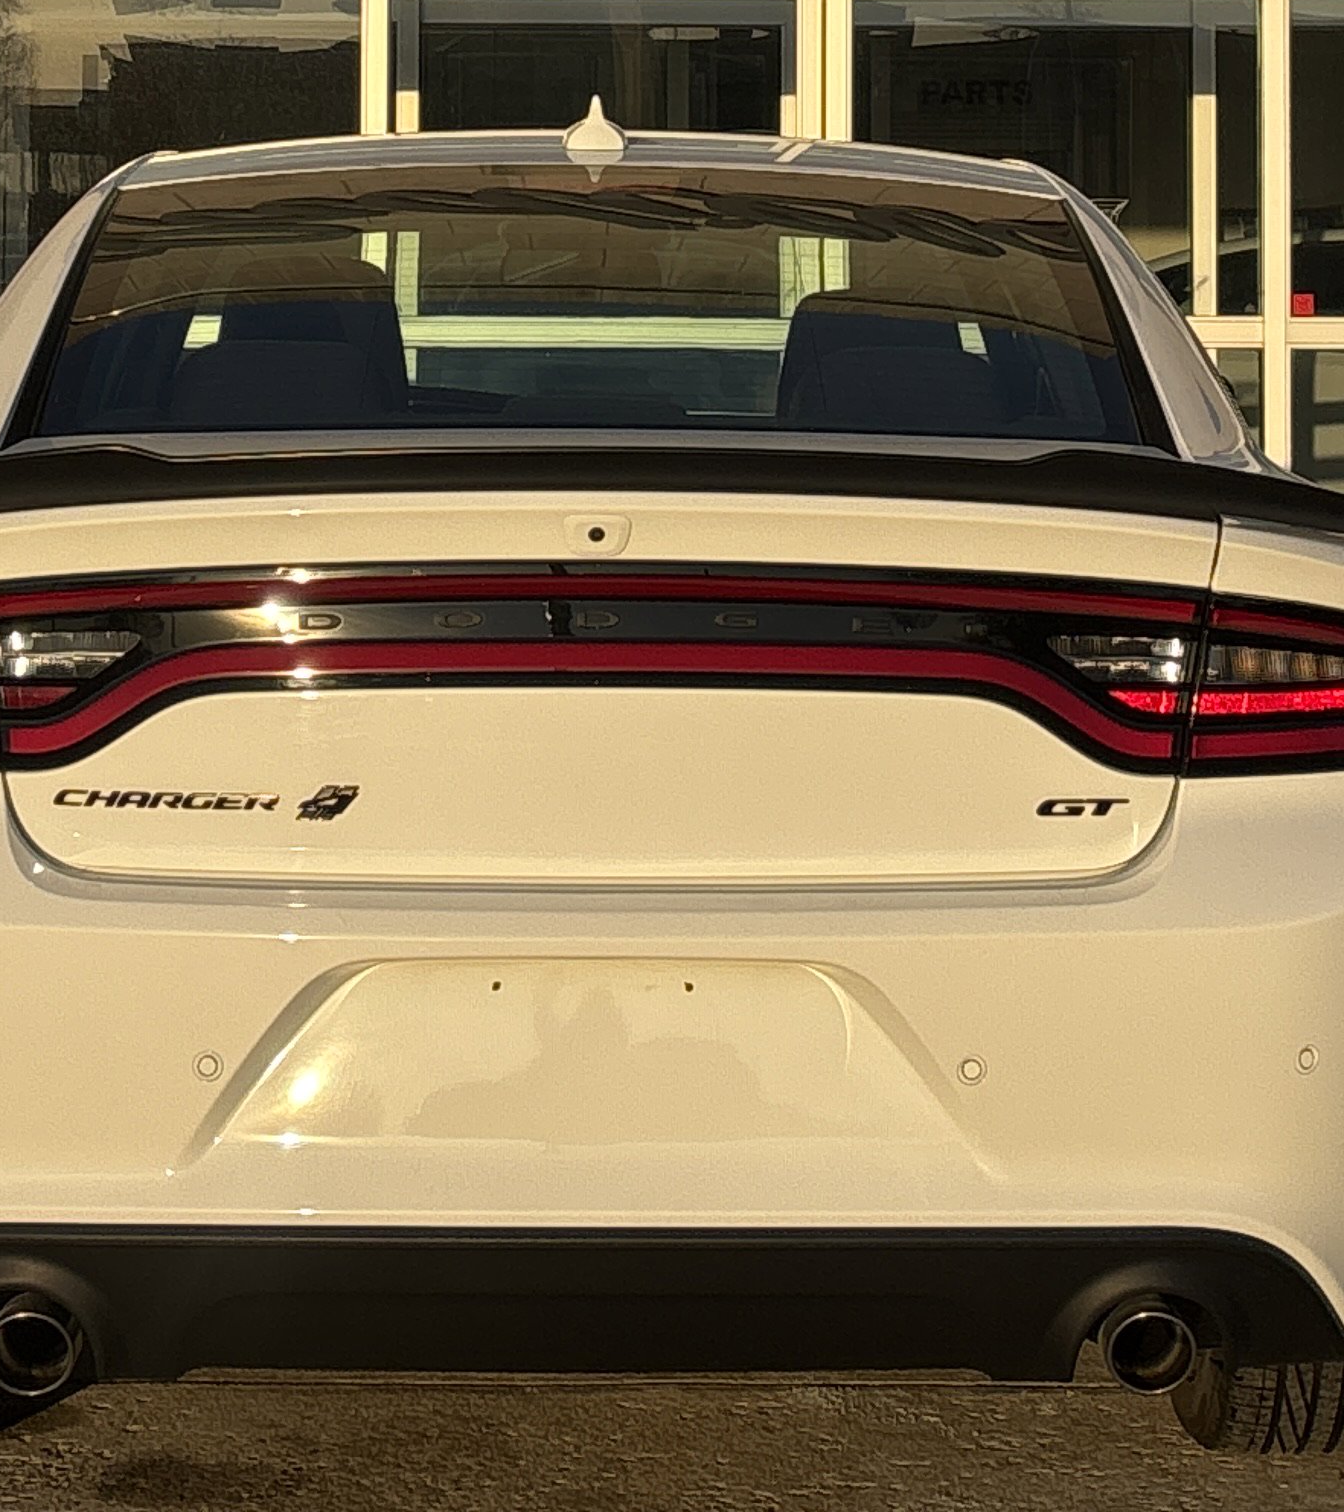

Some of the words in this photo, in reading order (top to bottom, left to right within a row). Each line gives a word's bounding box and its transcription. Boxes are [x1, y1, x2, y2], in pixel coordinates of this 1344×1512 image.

[922, 79, 1033, 105] PARTS
[301, 609, 891, 634] DODGE
[53, 789, 280, 811] CHARGER
[1036, 798, 1130, 816] GT
